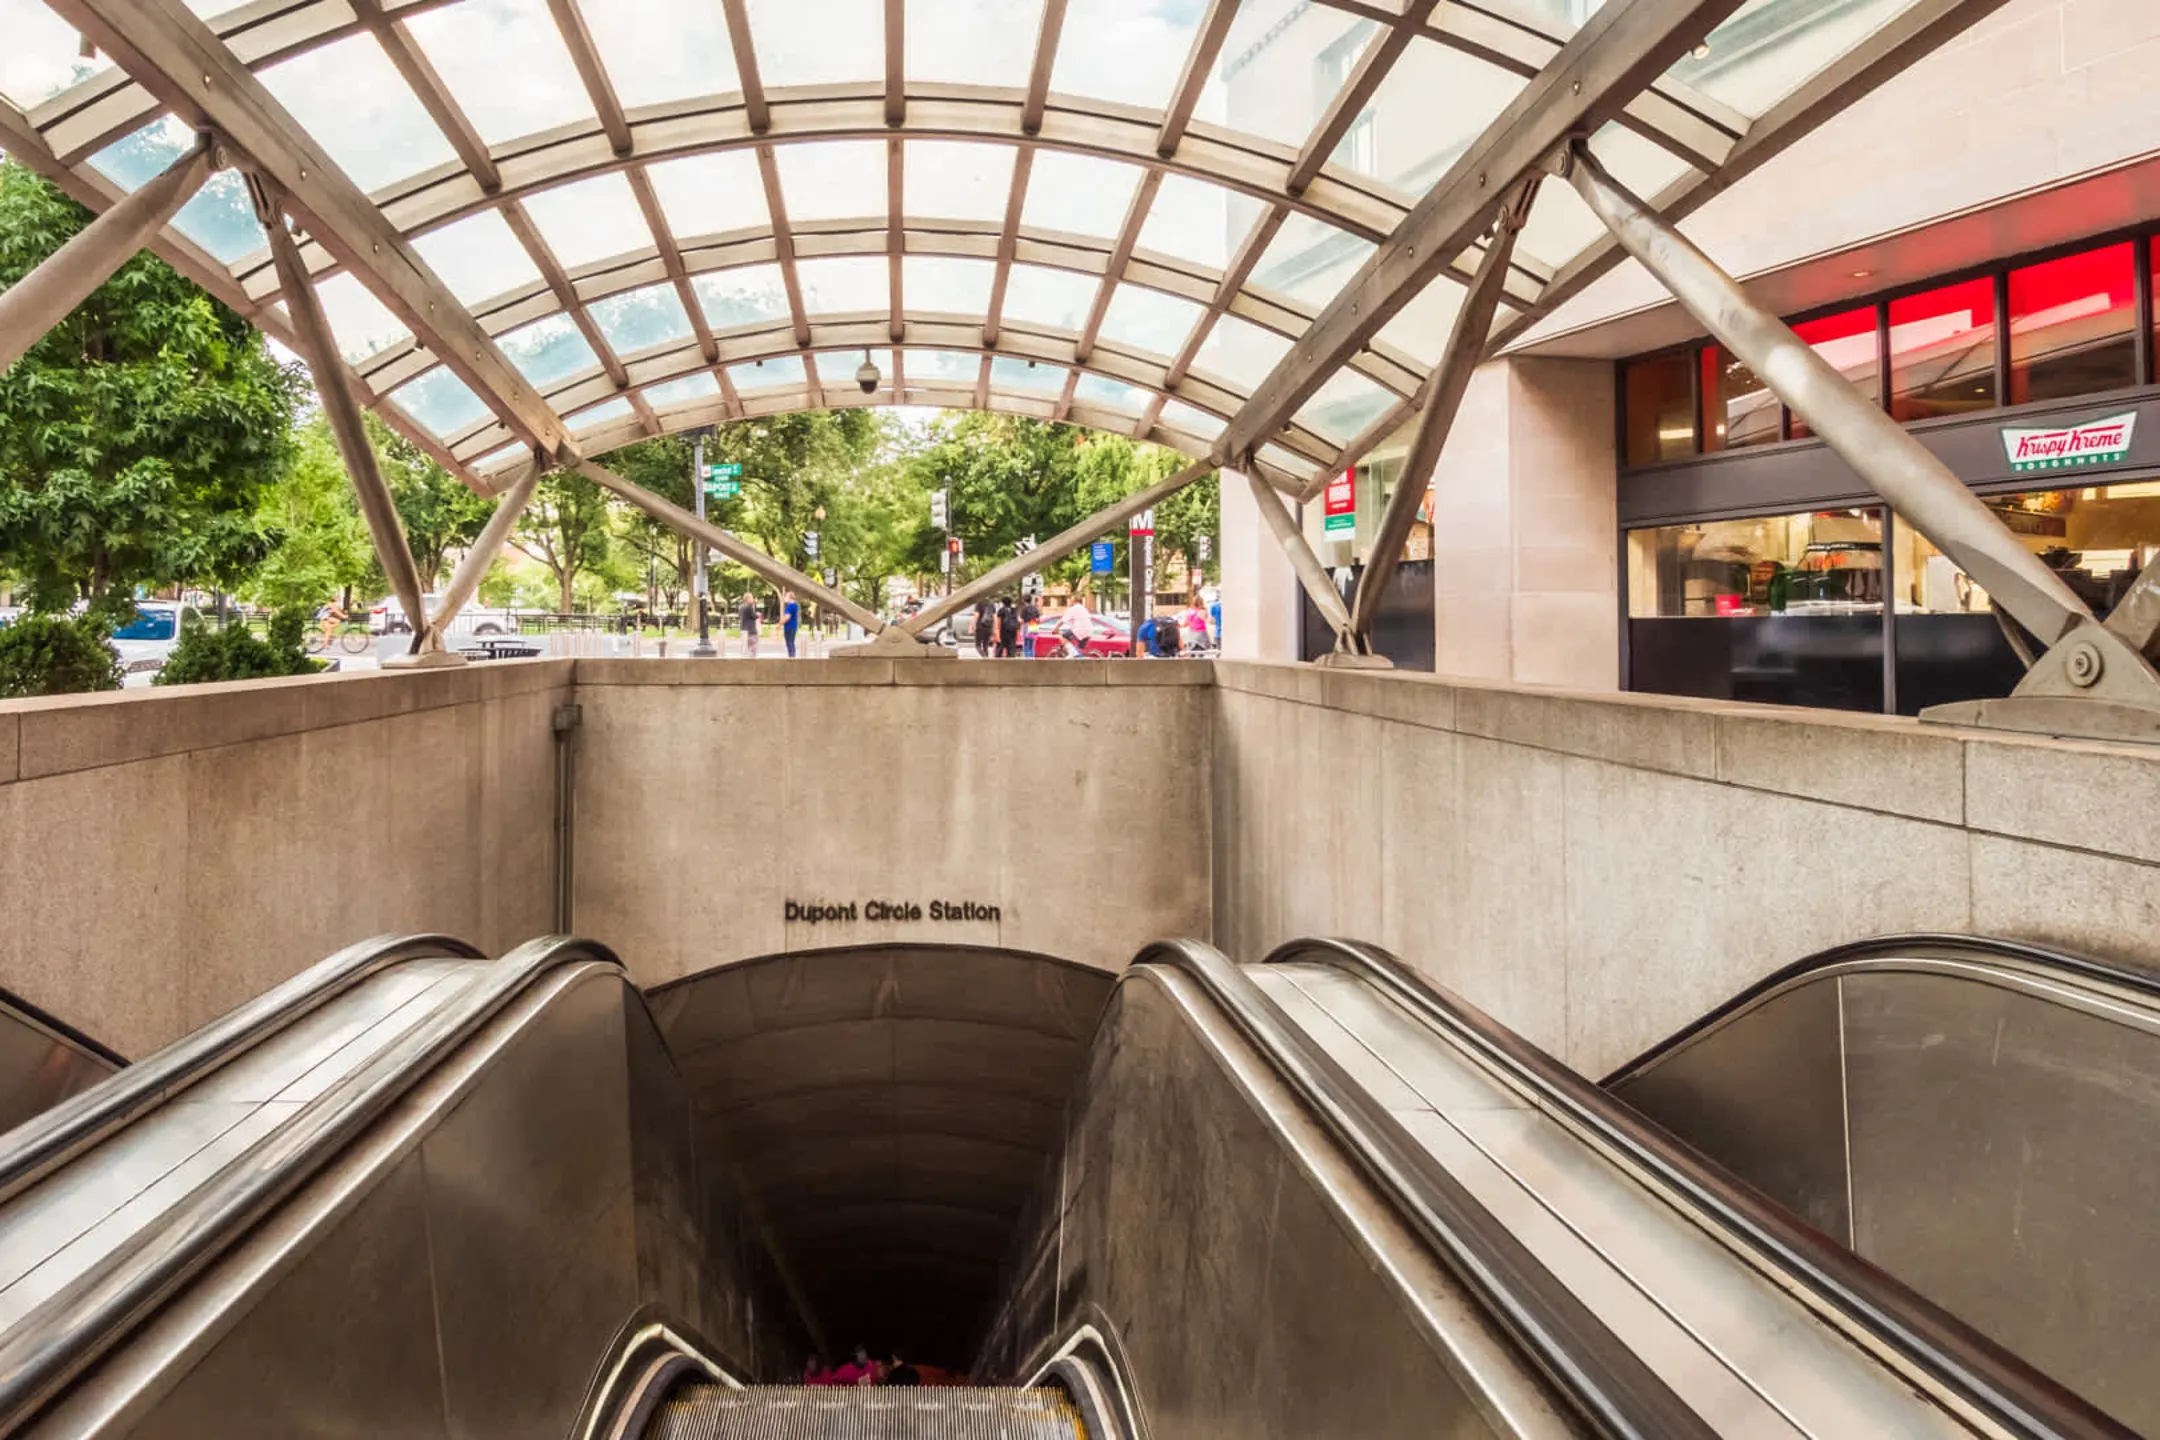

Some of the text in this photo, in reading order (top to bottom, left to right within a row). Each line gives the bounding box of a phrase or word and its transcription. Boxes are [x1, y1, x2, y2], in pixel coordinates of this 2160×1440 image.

[2016, 424, 2125, 458] Krispy Kreme
[2015, 453, 2121, 471] DOUGHNUTS
[1132, 509, 1153, 530] M
[785, 900, 1001, 924] Dupont Circle Station
